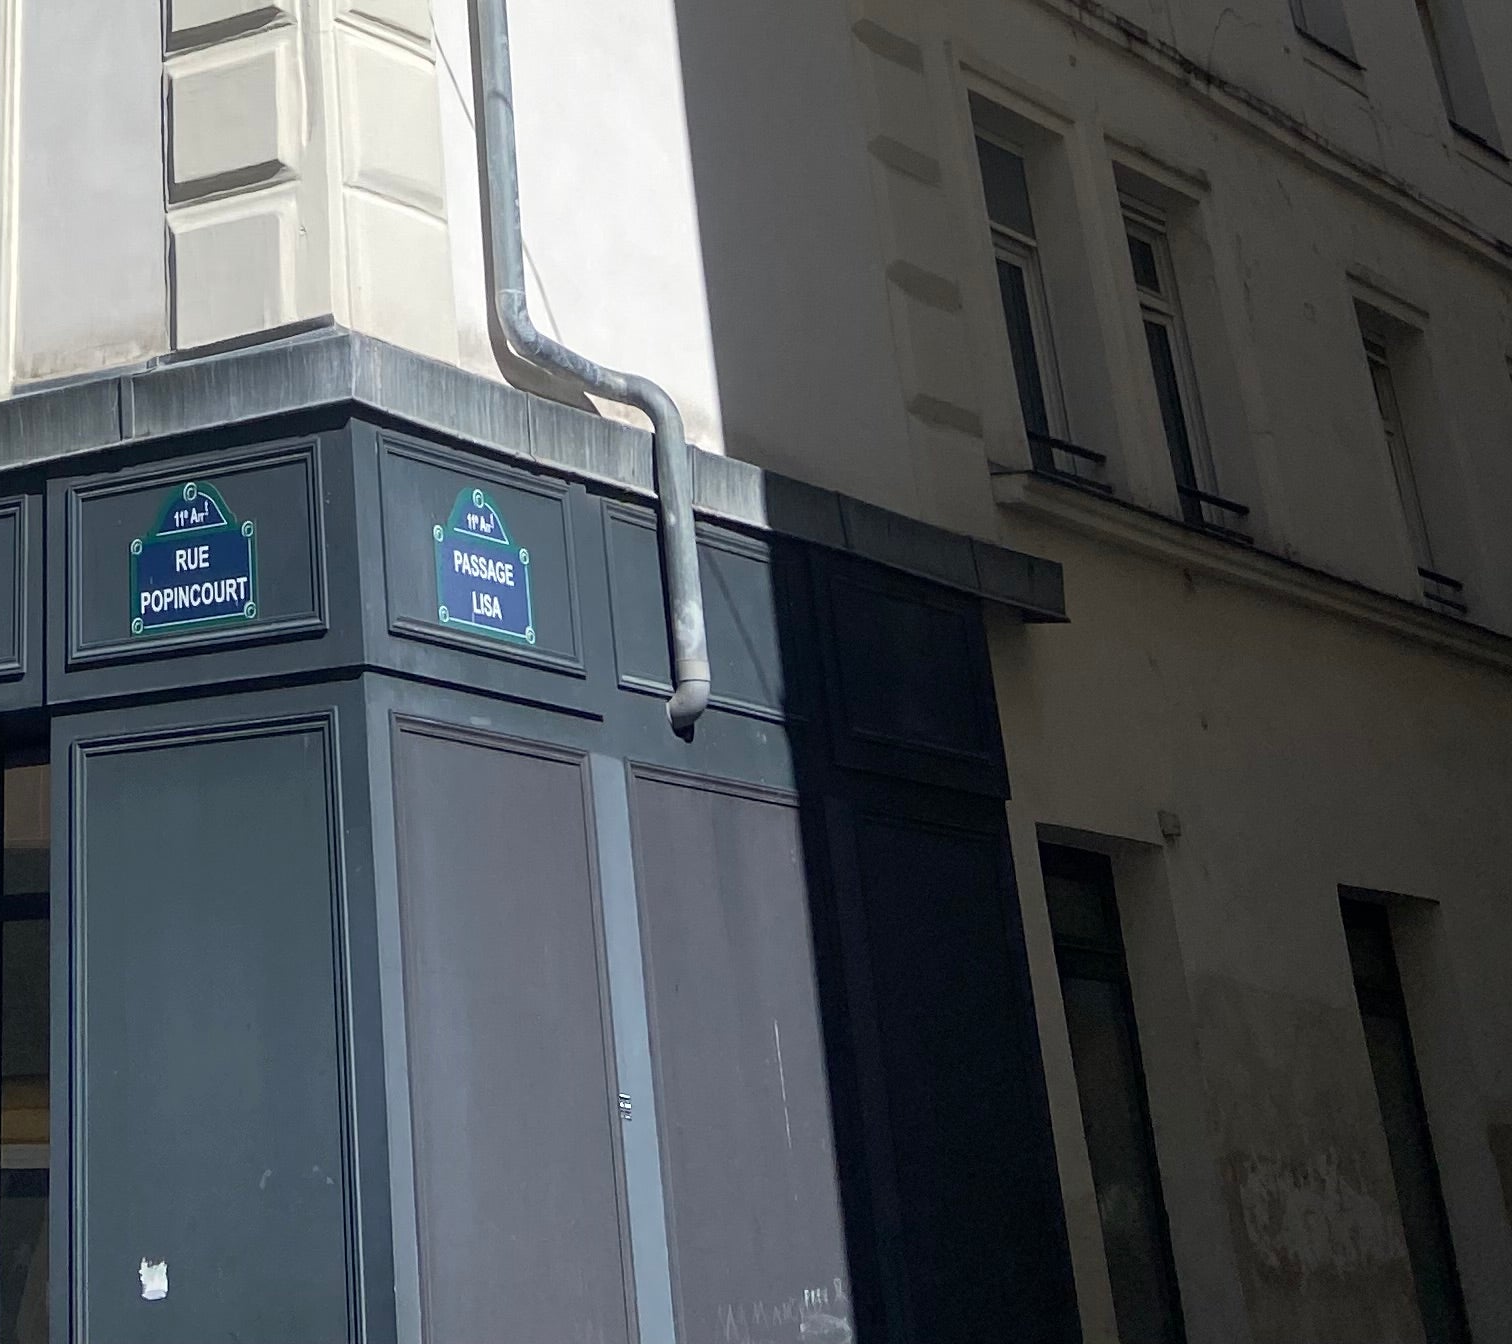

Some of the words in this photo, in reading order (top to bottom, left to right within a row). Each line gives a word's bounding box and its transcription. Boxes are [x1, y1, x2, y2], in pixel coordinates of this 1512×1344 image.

[175, 545, 210, 572] RUE
[453, 550, 515, 587] PASSAGE
[140, 576, 248, 615] POPINCOURT
[471, 591, 503, 620] LISA
